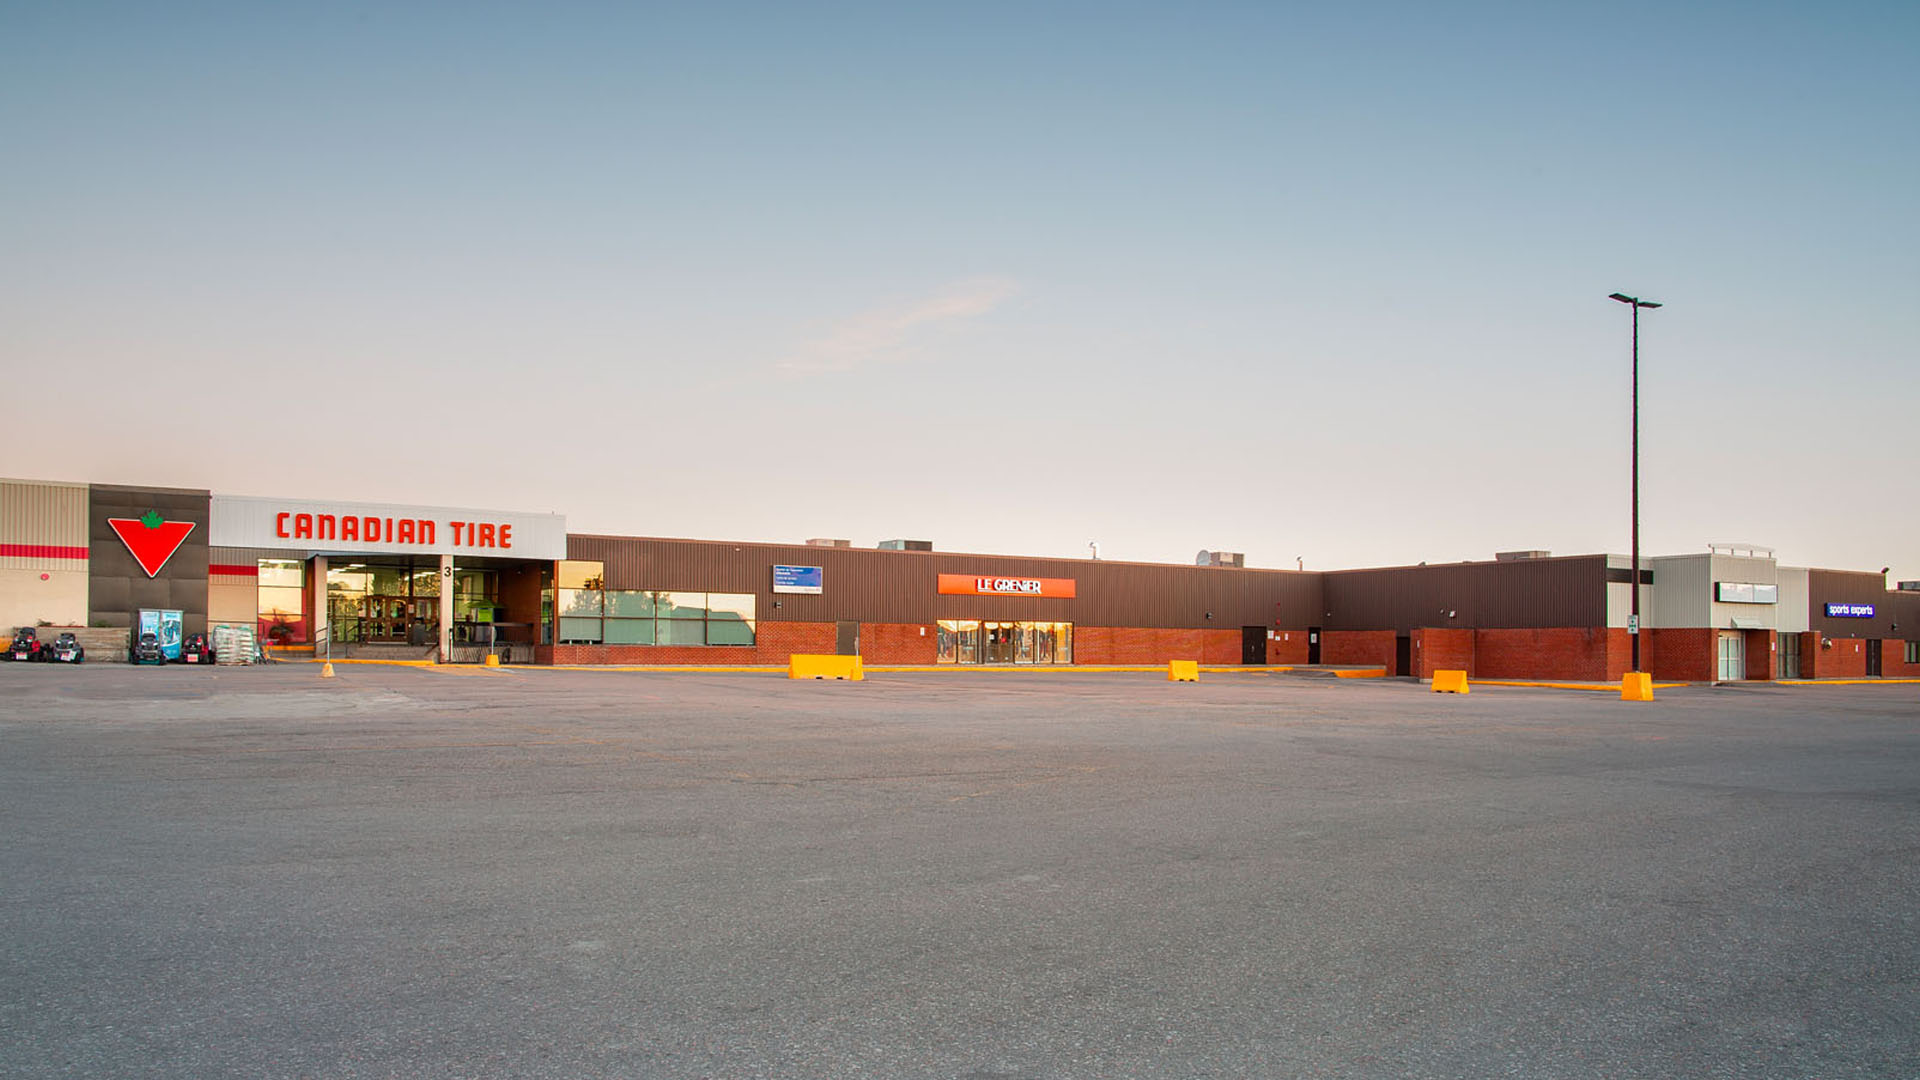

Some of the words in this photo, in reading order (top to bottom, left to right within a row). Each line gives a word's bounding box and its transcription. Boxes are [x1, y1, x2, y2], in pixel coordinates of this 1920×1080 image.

[276, 512, 435, 545] CANADIAN
[449, 521, 512, 548] TIRE
[443, 566, 452, 578] 3
[977, 578, 992, 592] LE
[1829, 605, 1849, 616] sports
[1851, 605, 1873, 616] experts
